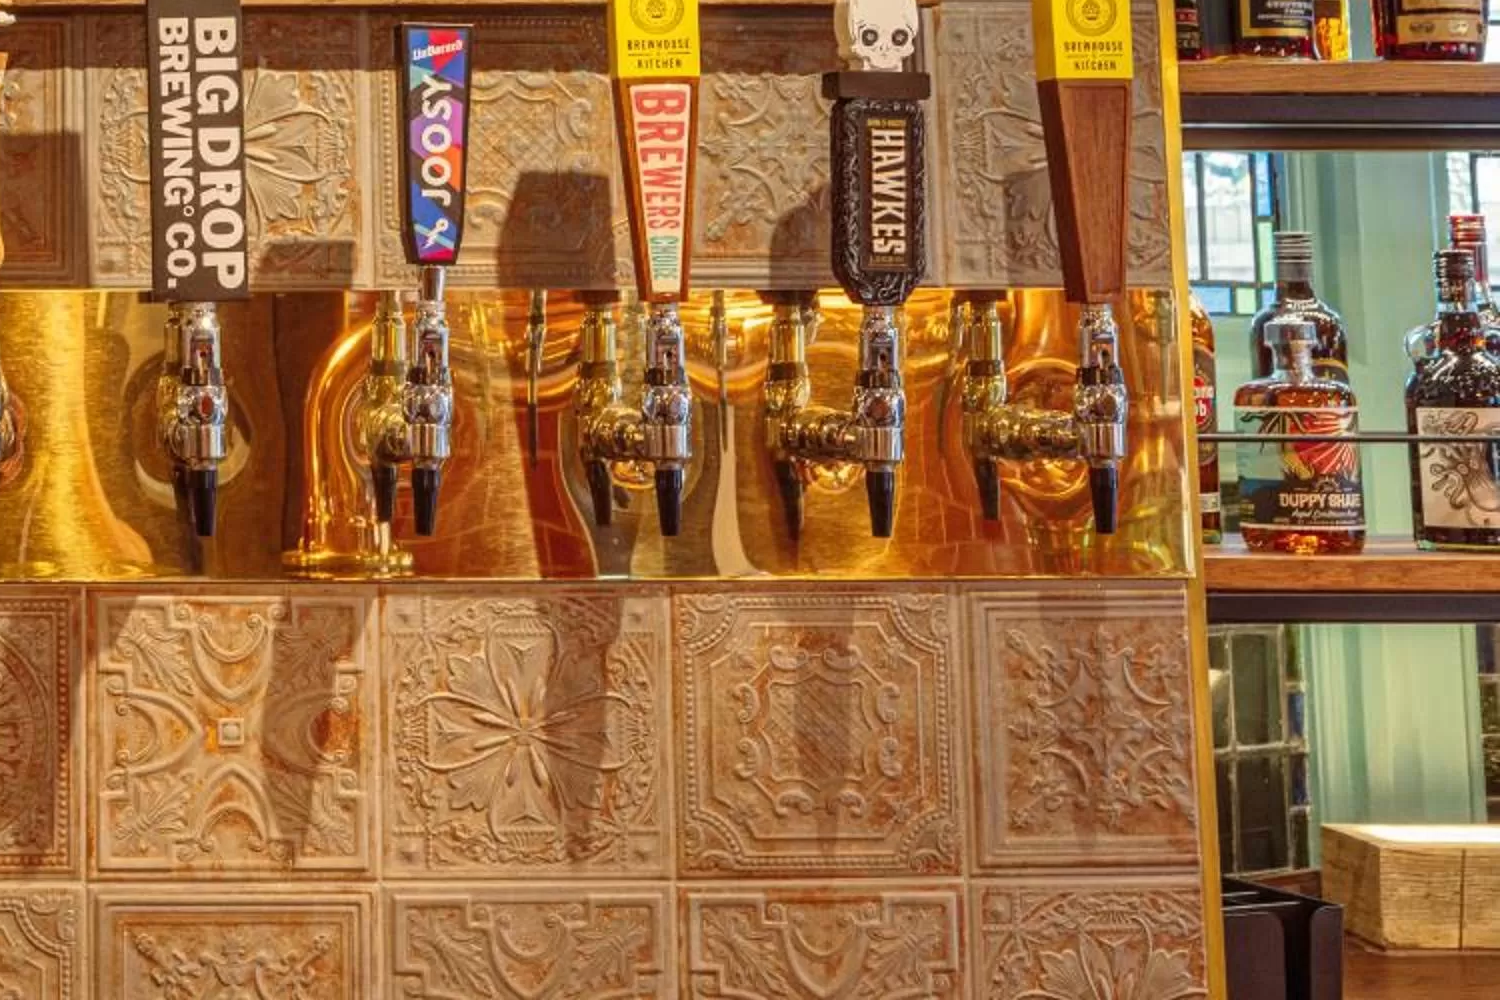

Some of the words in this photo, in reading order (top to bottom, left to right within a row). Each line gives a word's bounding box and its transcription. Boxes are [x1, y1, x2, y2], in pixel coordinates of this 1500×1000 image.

[194, 16, 238, 116] BIG
[627, 38, 690, 51] BREWHOUSE
[637, 58, 682, 69] KITCHEN
[1064, 41, 1124, 52] BREWHOUSE
[421, 74, 453, 206] JOOSY
[634, 91, 687, 230] BREWERS
[198, 127, 246, 290] DROP
[871, 129, 906, 254] HAWKES
[165, 222, 197, 288] CO.
[1279, 493, 1327, 508] DUPPY
